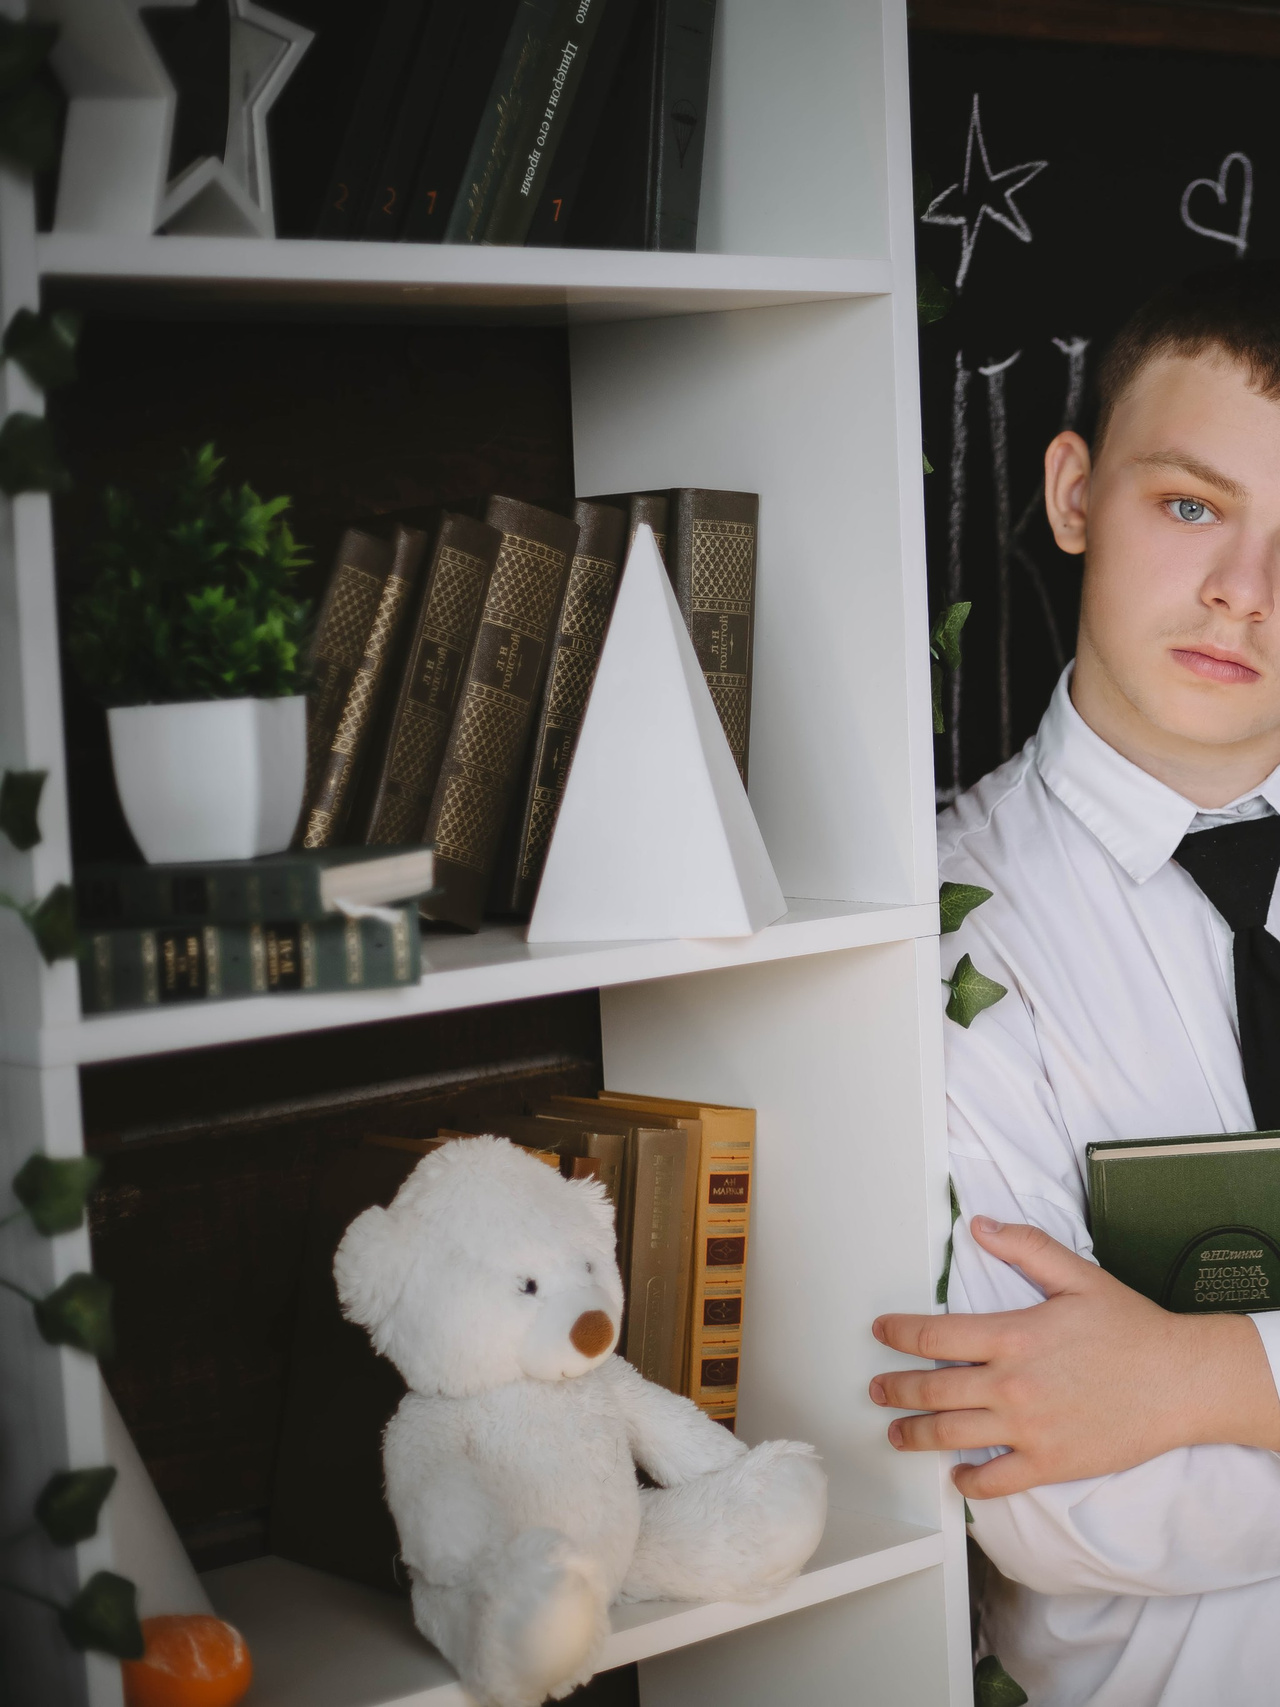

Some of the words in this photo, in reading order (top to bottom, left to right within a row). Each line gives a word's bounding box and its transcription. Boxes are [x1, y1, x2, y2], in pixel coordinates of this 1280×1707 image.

[549, 41, 579, 107] Цицерон
[545, 107, 556, 120] и
[536, 121, 550, 147] его
[520, 149, 542, 197] время
[334, 183, 349, 212] 2
[382, 187, 397, 215] 2
[426, 190, 437, 215] 1
[552, 198, 562, 222] 1
[718, 613, 729, 671] ТОЛСТОЙ
[501, 631, 521, 691] ТОЛСТОЙ
[1194, 1276, 1269, 1290] РУССКОГО
[1198, 1265, 1265, 1279] ПИСЬМА
[1195, 1288, 1270, 1302] ОФИЦЕРА
